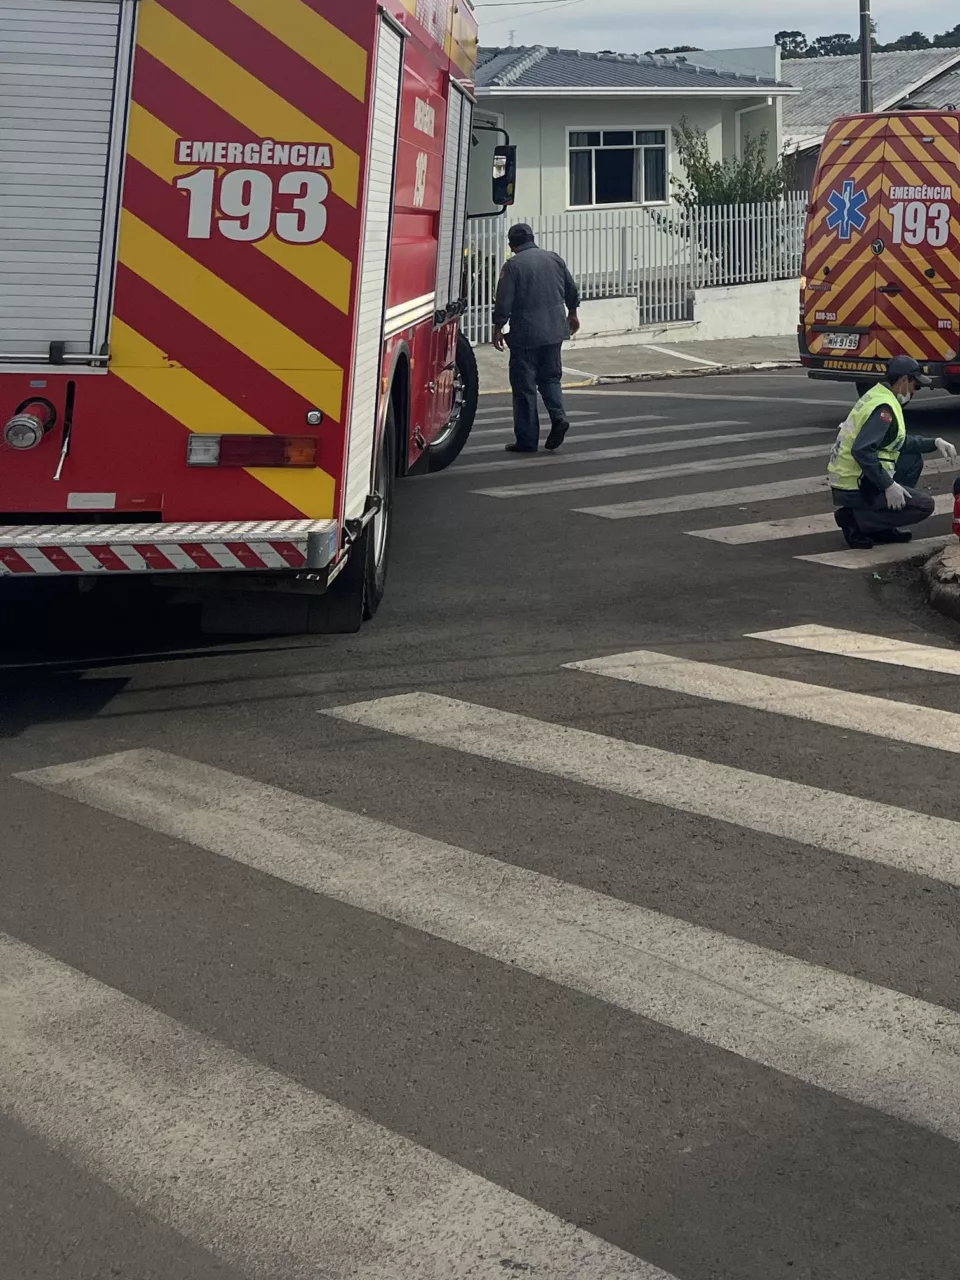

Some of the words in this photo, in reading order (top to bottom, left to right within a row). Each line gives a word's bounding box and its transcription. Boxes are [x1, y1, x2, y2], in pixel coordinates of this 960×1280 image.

[178, 140, 331, 167] EMERGÊNCIA
[176, 169, 329, 243] 193
[889, 184, 951, 200] EMERGÊNCIA
[889, 201, 950, 247] 193
